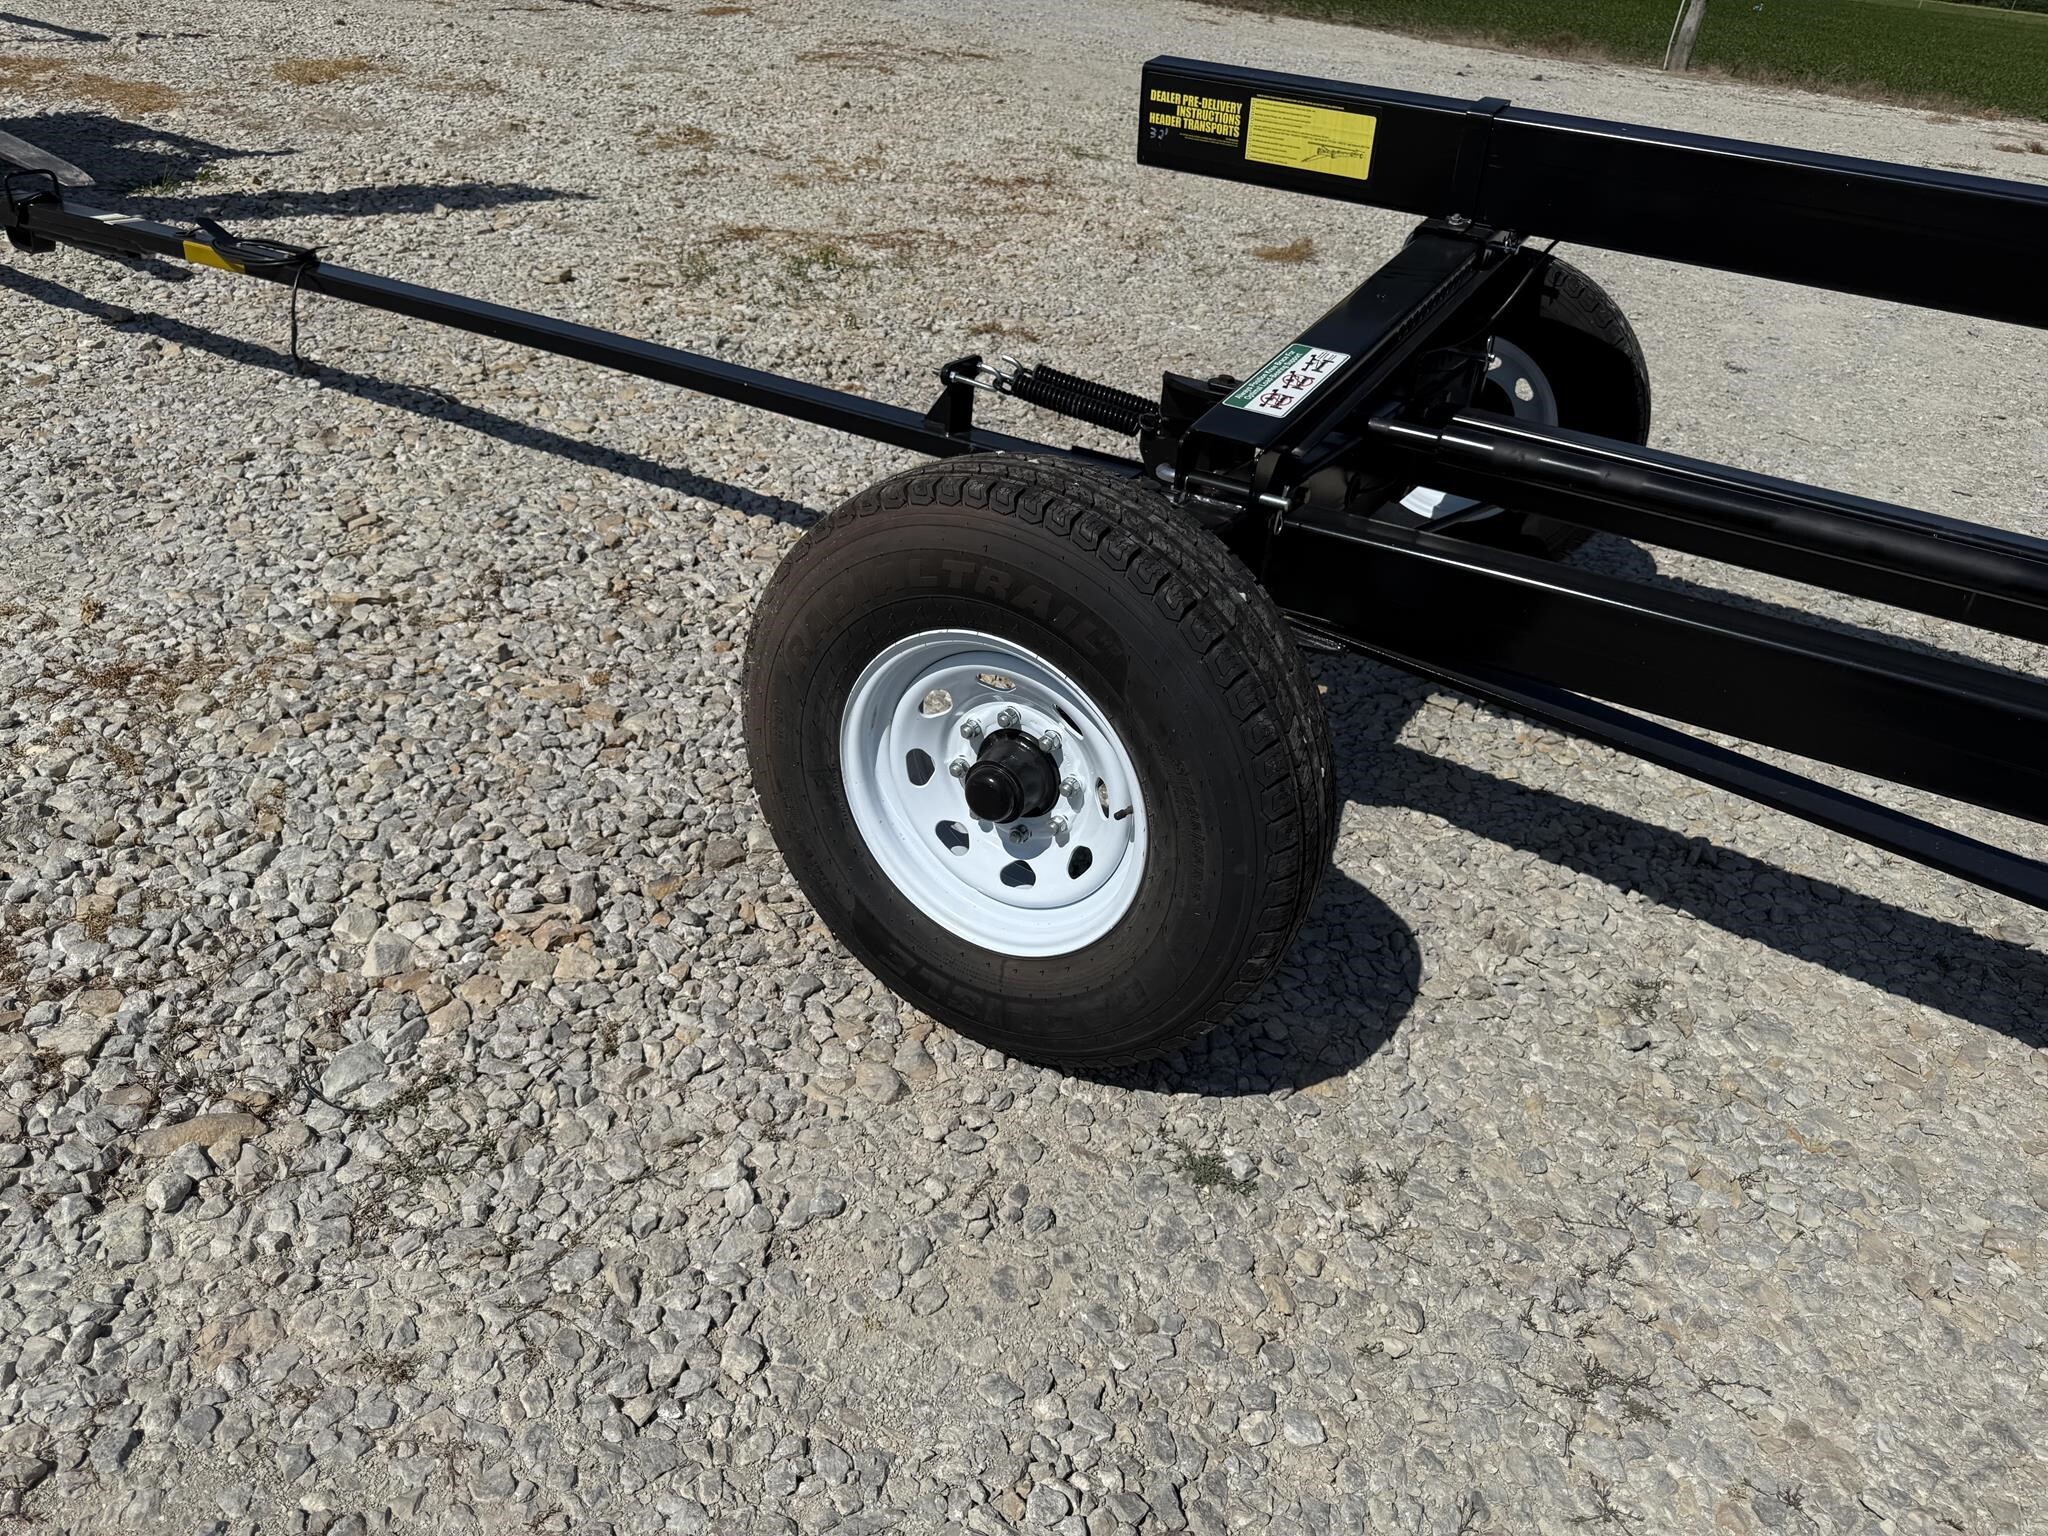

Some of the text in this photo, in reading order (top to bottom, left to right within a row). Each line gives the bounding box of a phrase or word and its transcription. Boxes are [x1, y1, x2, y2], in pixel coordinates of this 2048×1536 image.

[1150, 89, 1182, 105] DEALER
[1182, 94, 1242, 112] PRE-DELIVERY
[1149, 112, 1240, 138] HEADER TRANSPORTS
[1176, 105, 1241, 126] INSTRUCTIONS
